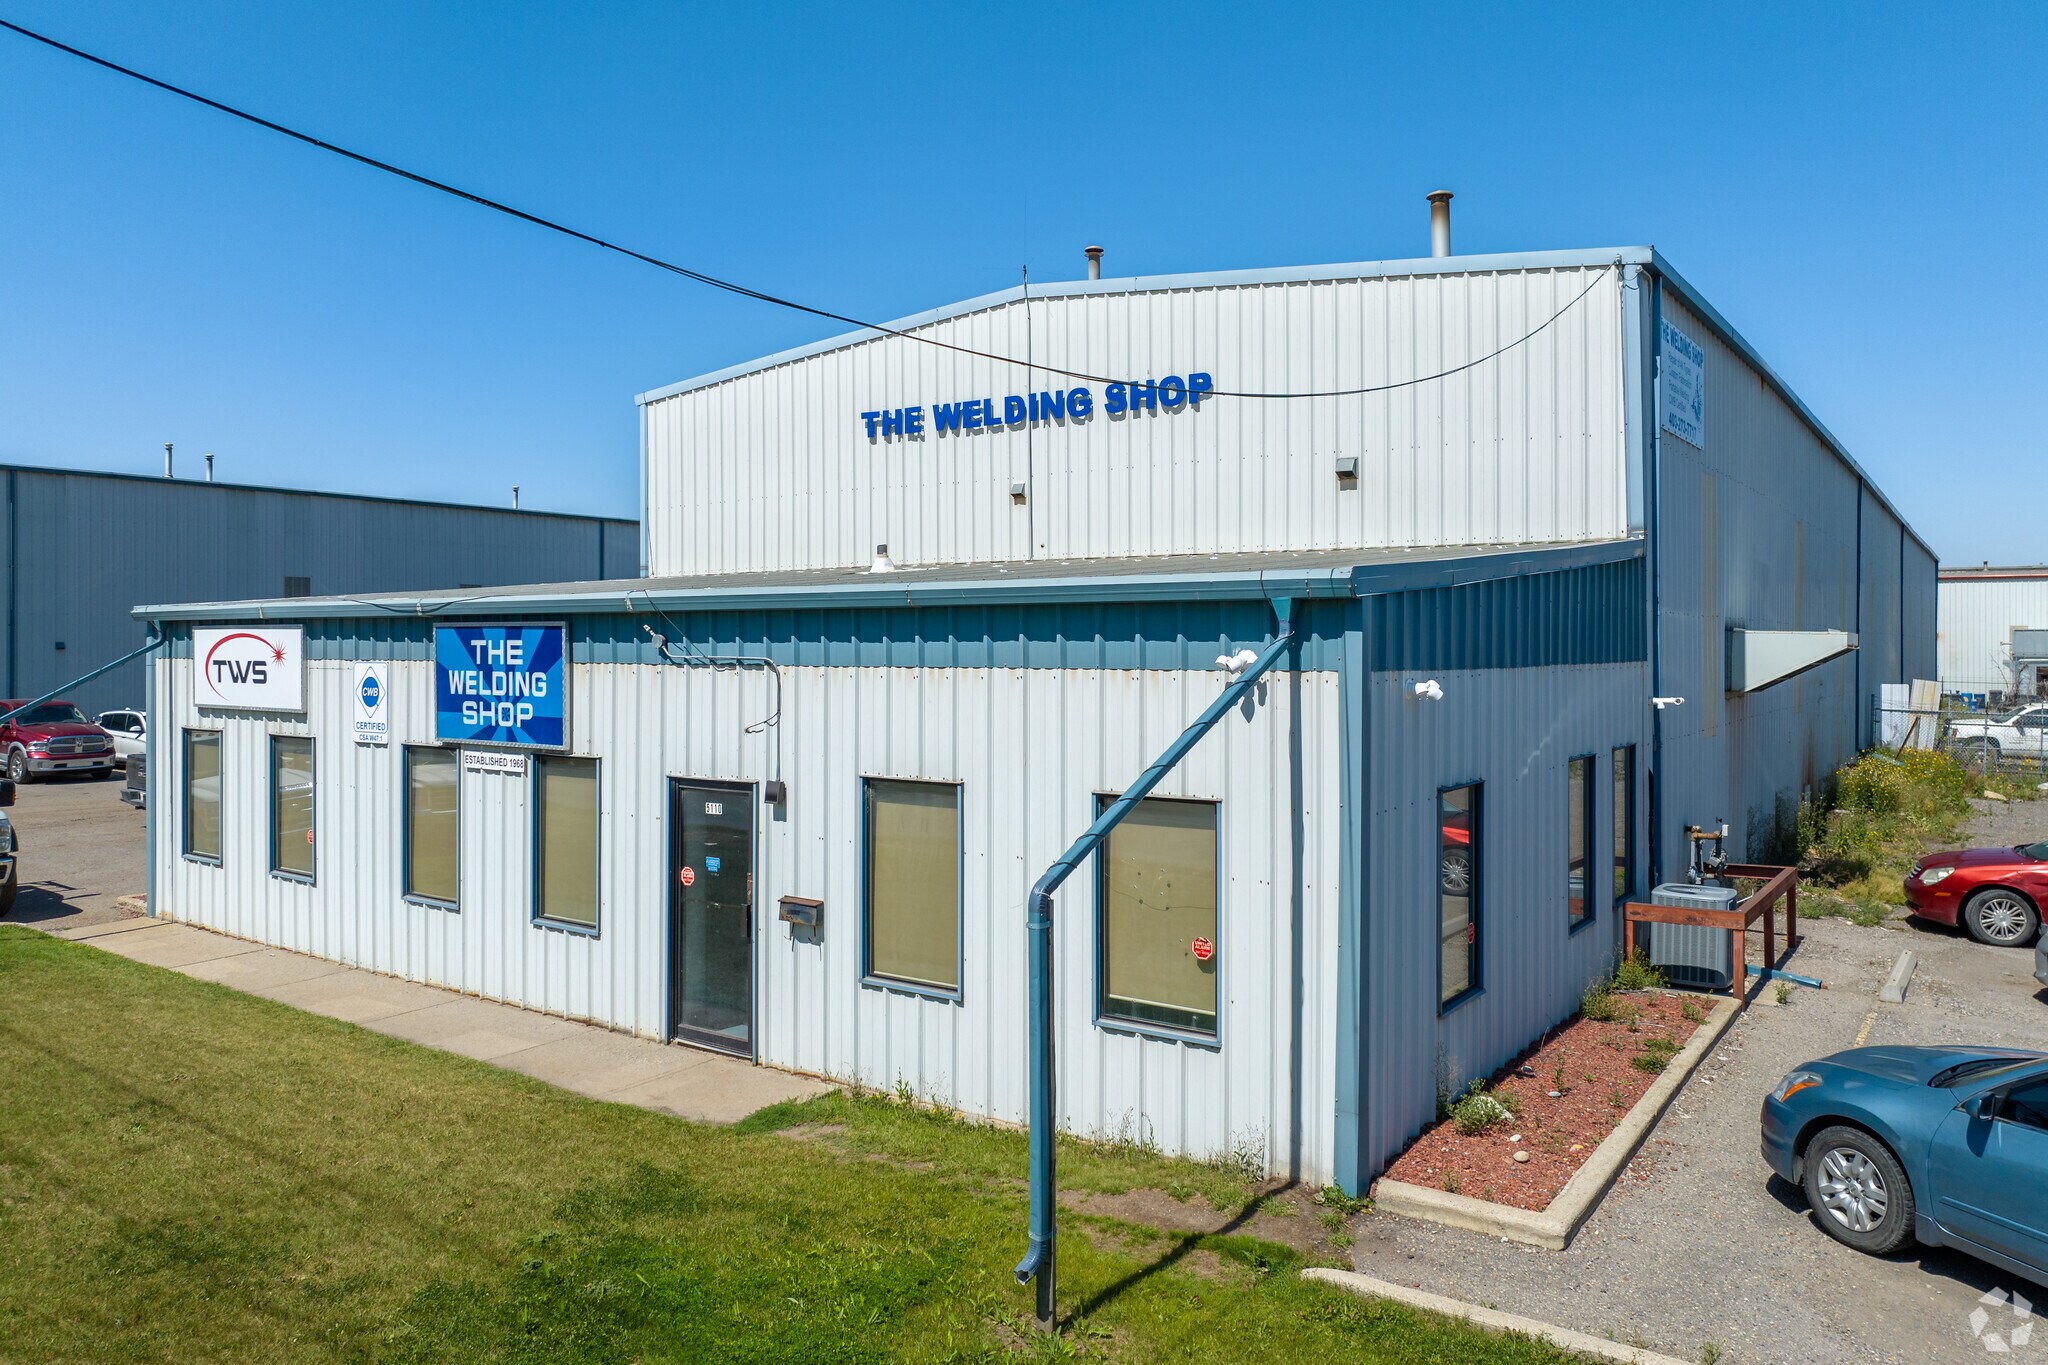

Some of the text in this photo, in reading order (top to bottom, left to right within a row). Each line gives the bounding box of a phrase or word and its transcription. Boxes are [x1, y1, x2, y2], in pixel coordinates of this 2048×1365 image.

[861, 372, 1213, 438] THE WELDING SHOP
[471, 640, 524, 665] THE
[213, 660, 267, 684] TWS
[449, 670, 547, 697] WELDING
[362, 687, 379, 697] CWB
[356, 721, 386, 731] CERTIFIED
[462, 701, 534, 727] SHOP
[465, 754, 524, 768] ESTABLISHED 1968
[706, 803, 722, 814] 5110
